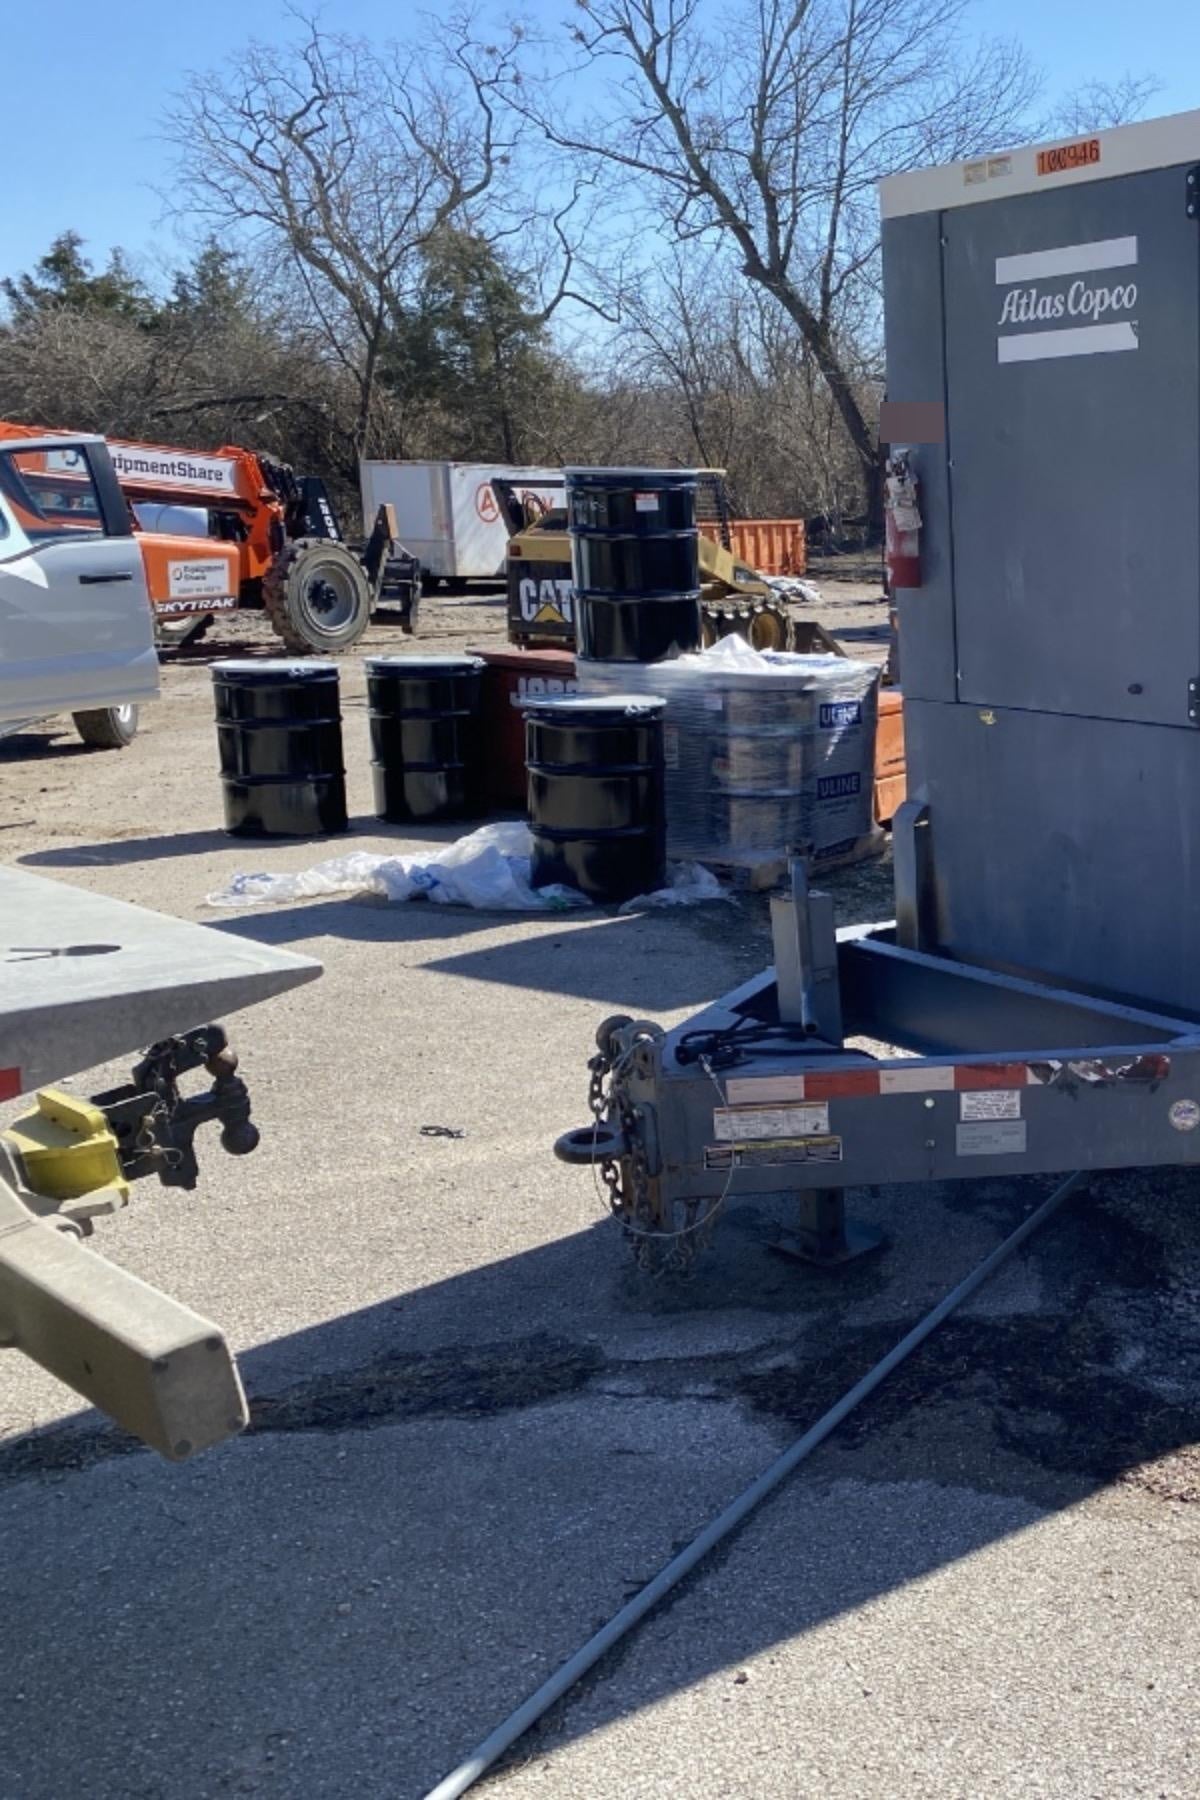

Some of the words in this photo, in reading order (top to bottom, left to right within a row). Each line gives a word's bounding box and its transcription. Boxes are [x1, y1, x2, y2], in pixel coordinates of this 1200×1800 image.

[998, 288, 1064, 325] Atlas
[1067, 280, 1138, 321] Copco
[156, 597, 236, 613] SKYTRAK
[519, 577, 573, 622] CAT
